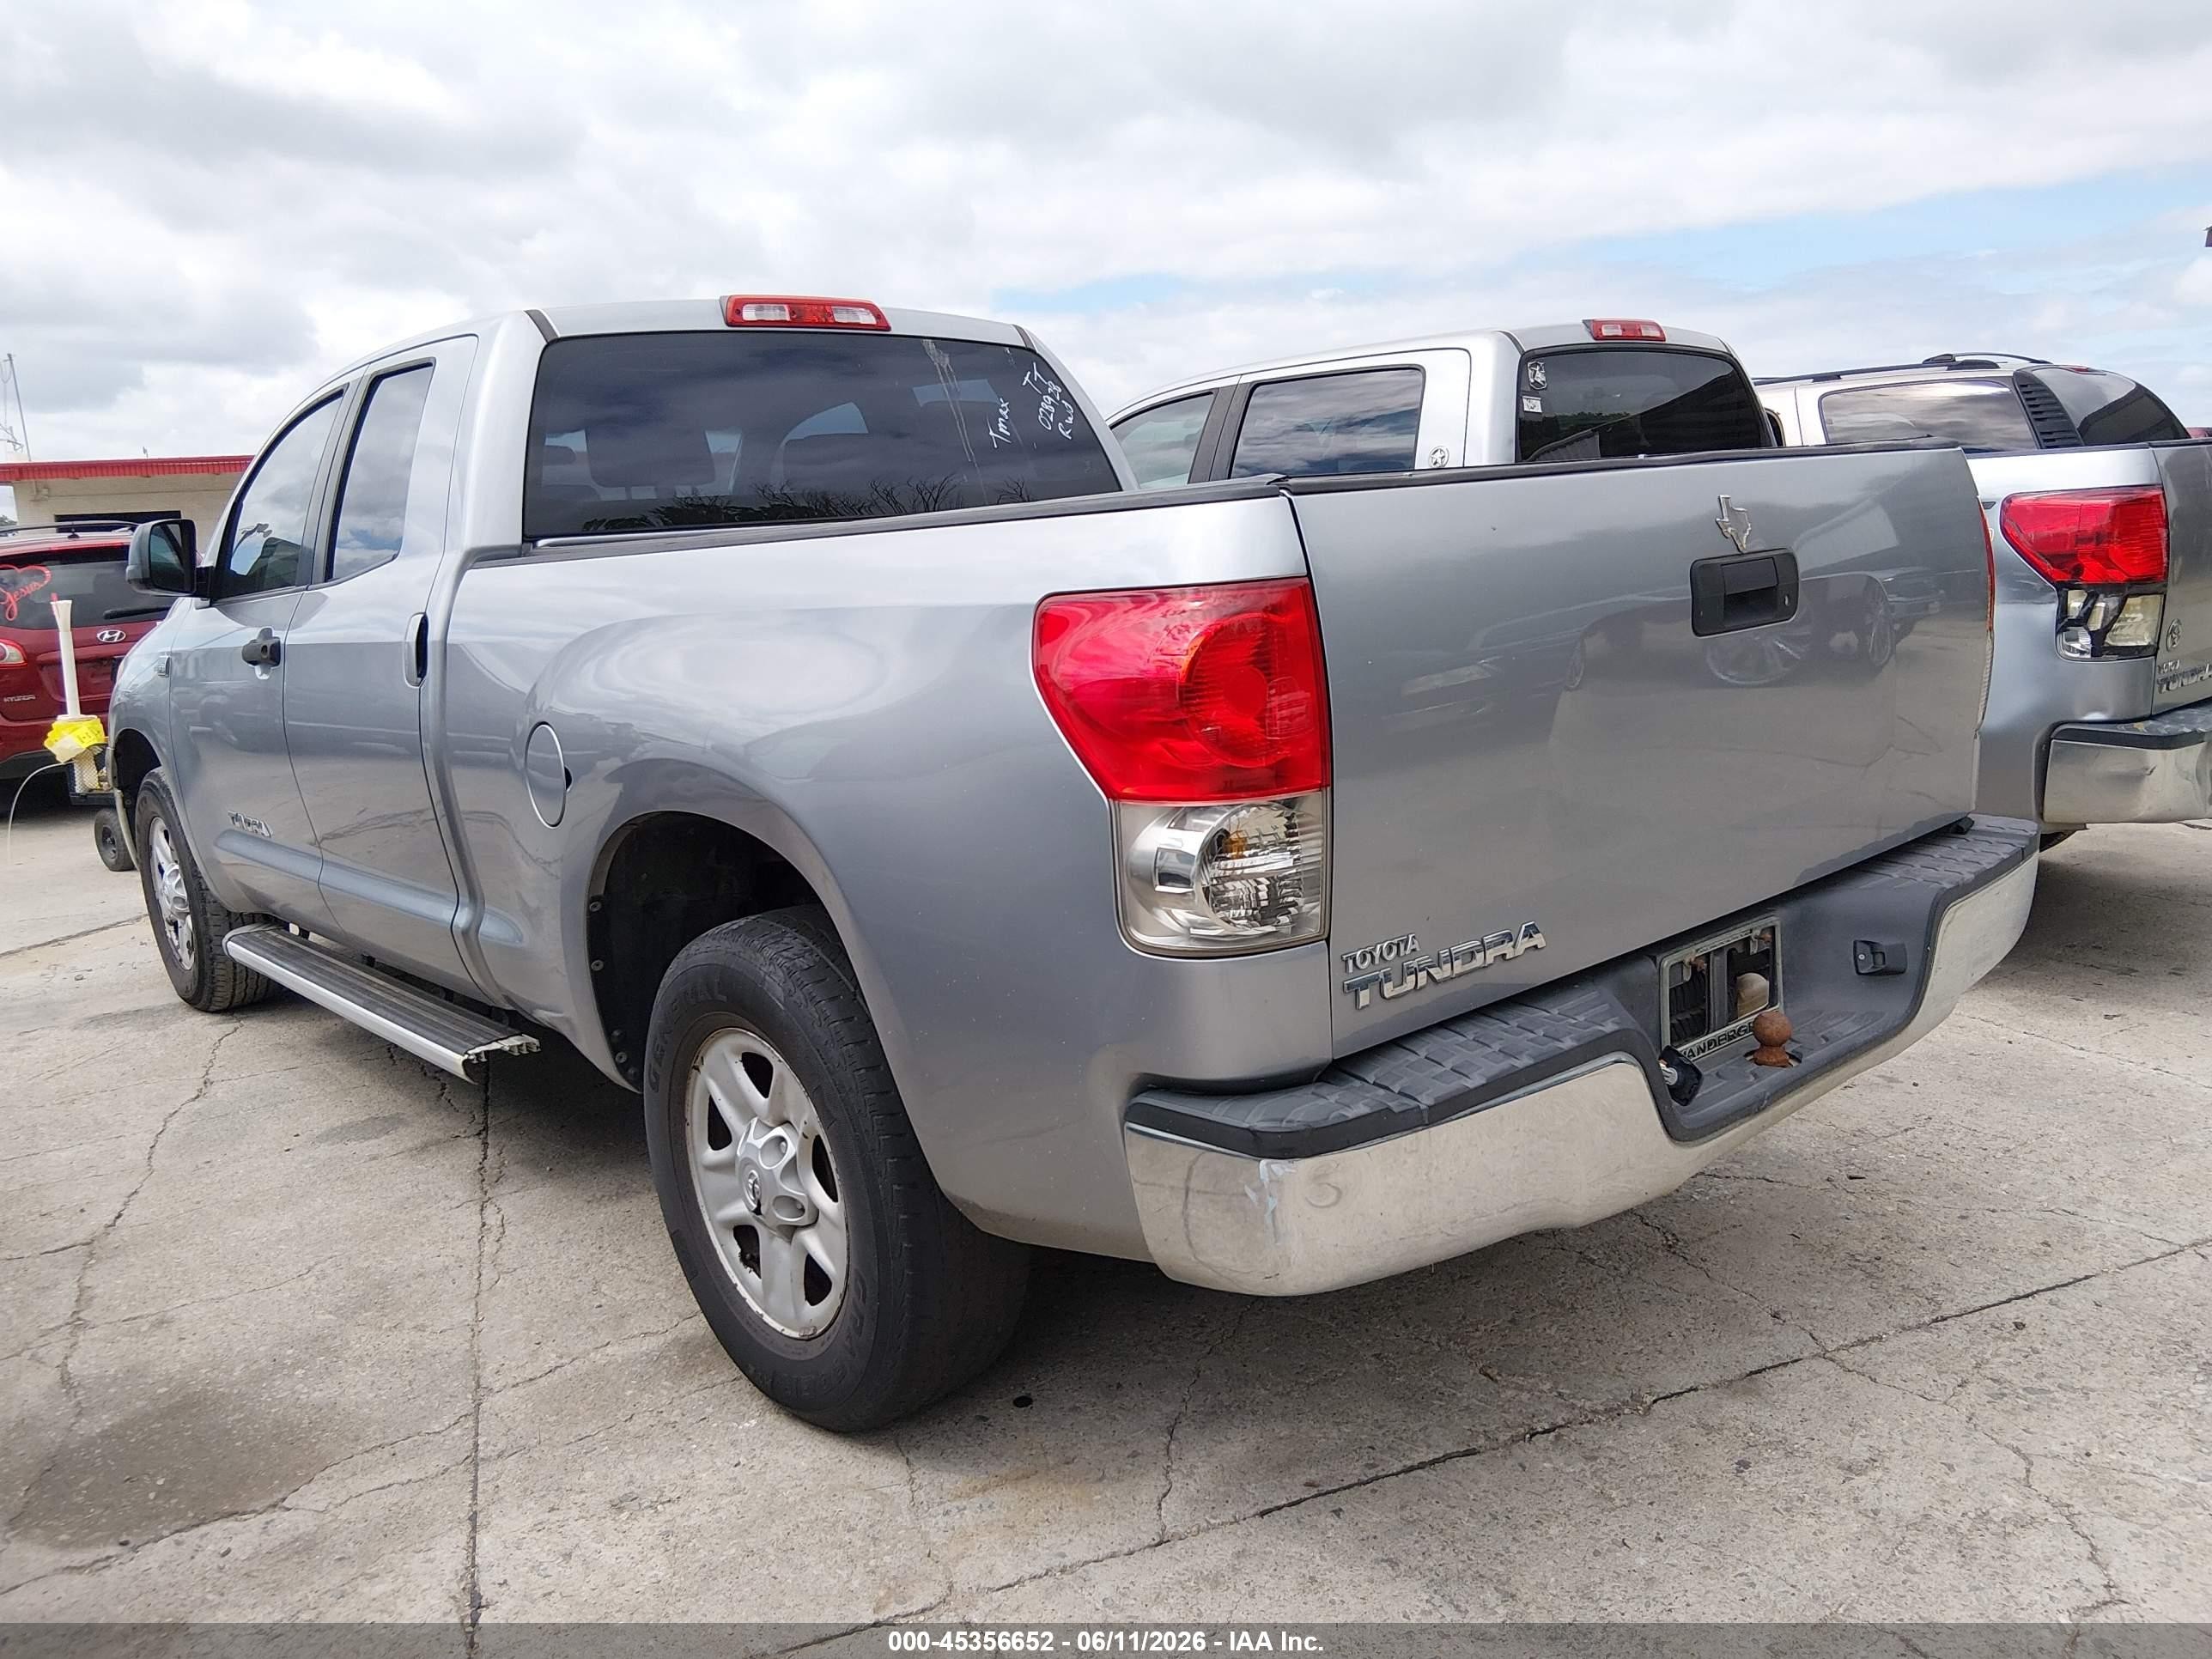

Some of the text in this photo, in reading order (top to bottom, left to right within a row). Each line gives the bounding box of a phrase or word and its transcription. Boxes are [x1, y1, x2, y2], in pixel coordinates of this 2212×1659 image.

[1038, 380, 1062, 430] 028928
[1341, 933, 1421, 974] TOYOTA
[1342, 921, 1547, 1010] TUNDRA
